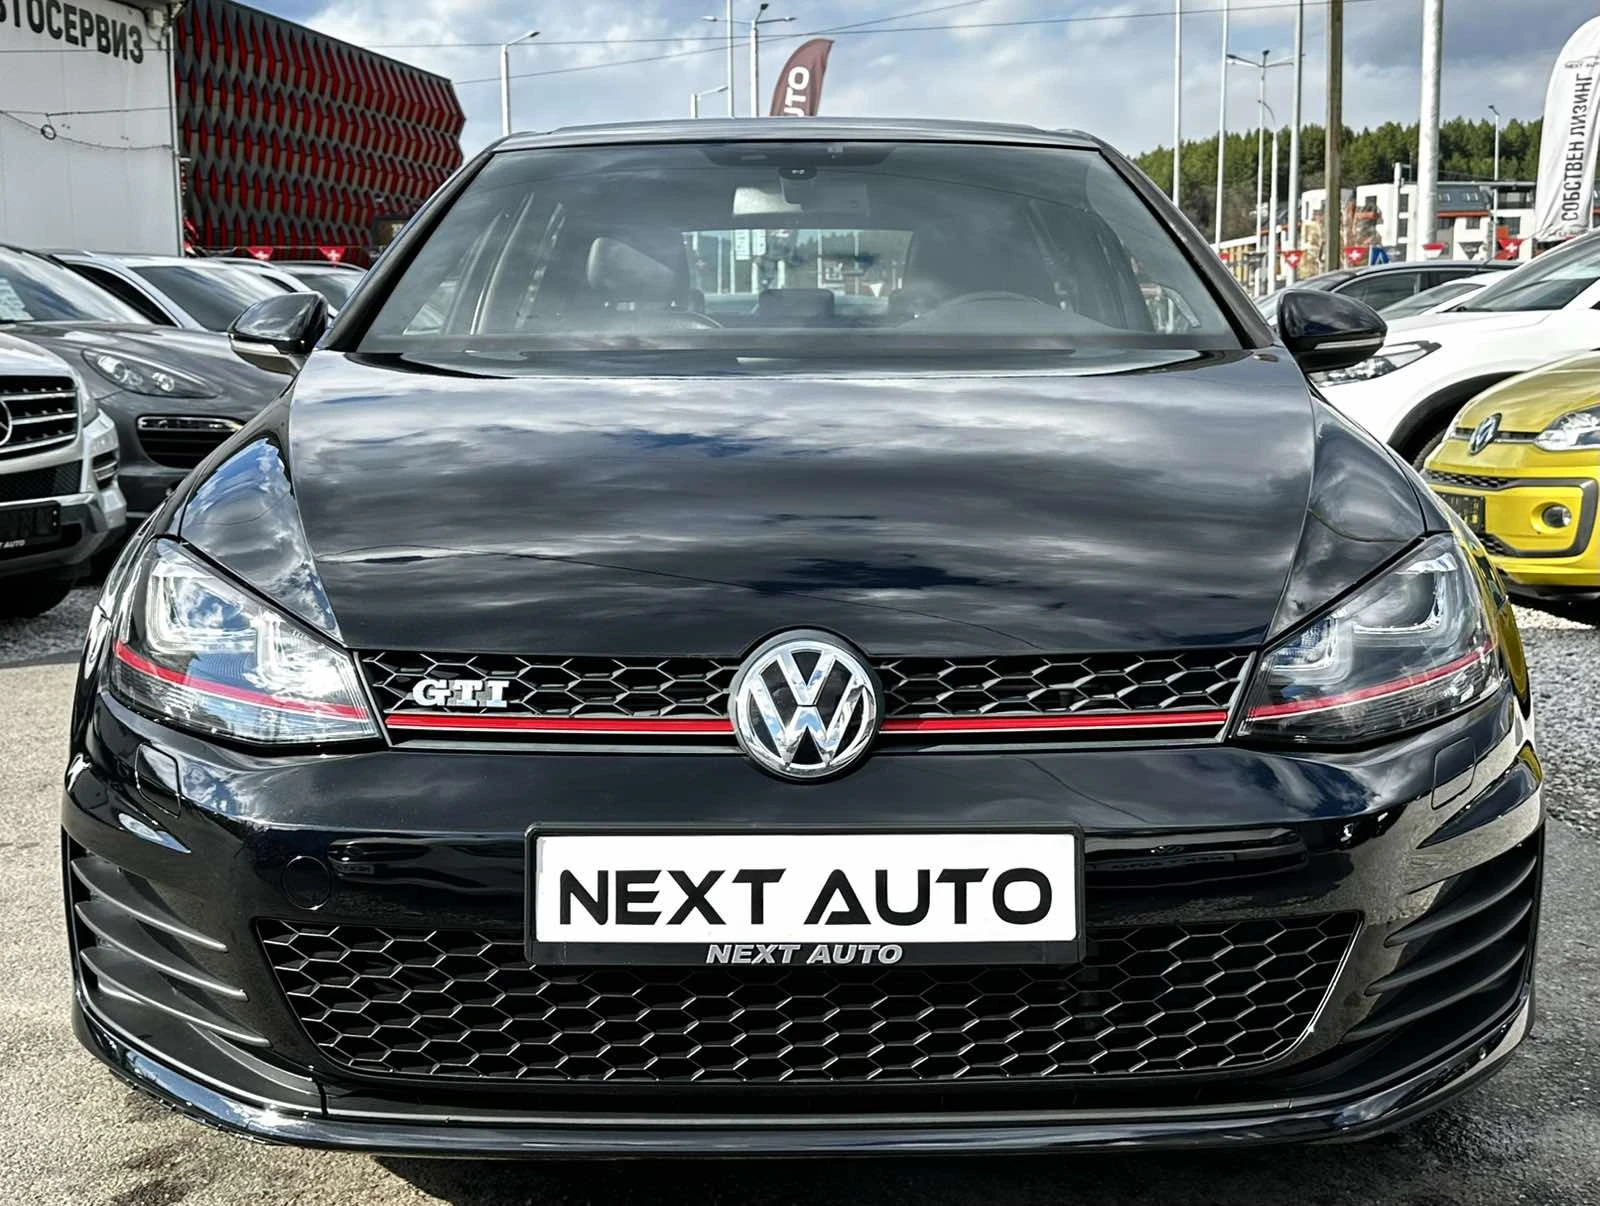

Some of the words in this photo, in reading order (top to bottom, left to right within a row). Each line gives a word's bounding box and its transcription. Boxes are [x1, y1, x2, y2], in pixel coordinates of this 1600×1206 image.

[0, 0, 144, 64] ТОСЕРВИЗ
[1570, 73, 1593, 137] ЛИЗИНГ
[1561, 141, 1585, 221] СОБСТВЕН
[412, 679, 510, 708] GTI
[559, 868, 787, 926] NEXT
[803, 867, 1053, 926] AUTO
[705, 944, 801, 965] NEXT
[806, 944, 904, 965] AUTO
